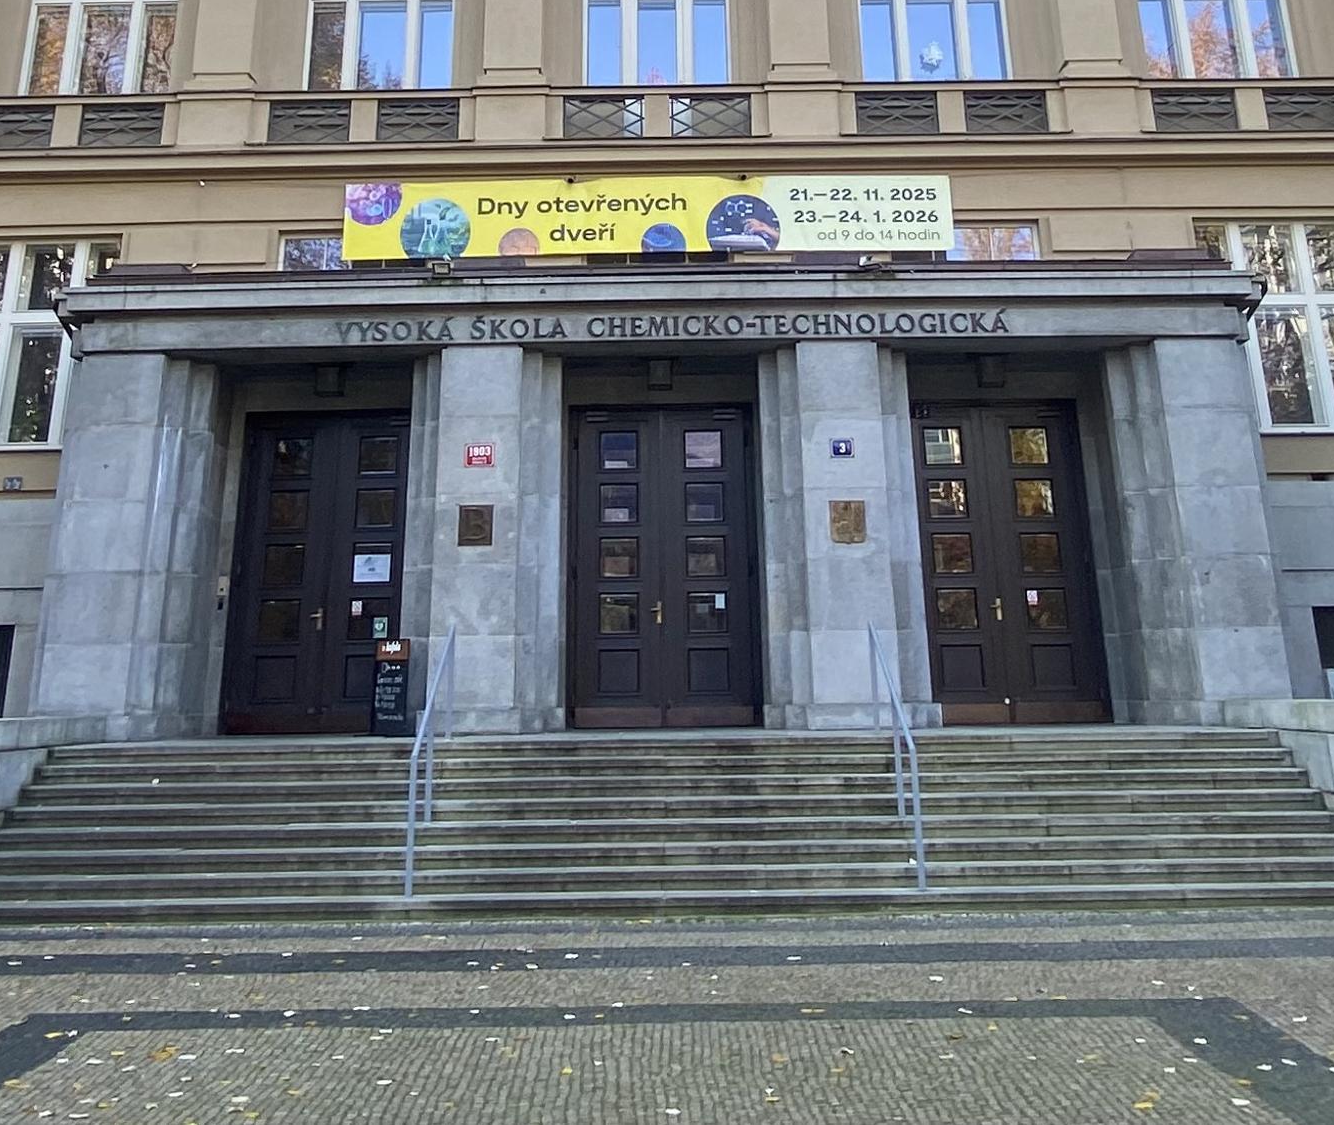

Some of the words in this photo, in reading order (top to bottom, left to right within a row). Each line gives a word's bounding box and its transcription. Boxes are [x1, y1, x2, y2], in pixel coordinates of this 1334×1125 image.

[863, 188, 884, 201] 11.
[890, 188, 937, 201] 2025
[477, 197, 529, 219] Dny
[536, 193, 687, 216] otevřených
[873, 210, 886, 223] 1.
[892, 210, 939, 223] 2026
[549, 223, 616, 242] dveří
[817, 229, 837, 241] od
[841, 229, 850, 241] 9
[854, 229, 875, 241] do
[880, 229, 893, 240] 14
[897, 229, 940, 241] hodin
[334, 316, 455, 343] VYSOKÁ
[470, 315, 569, 340] ŠKOLA
[586, 307, 1009, 339] CHEMICKO-TECHNOLOGICKÁ
[839, 442, 846, 453] 3
